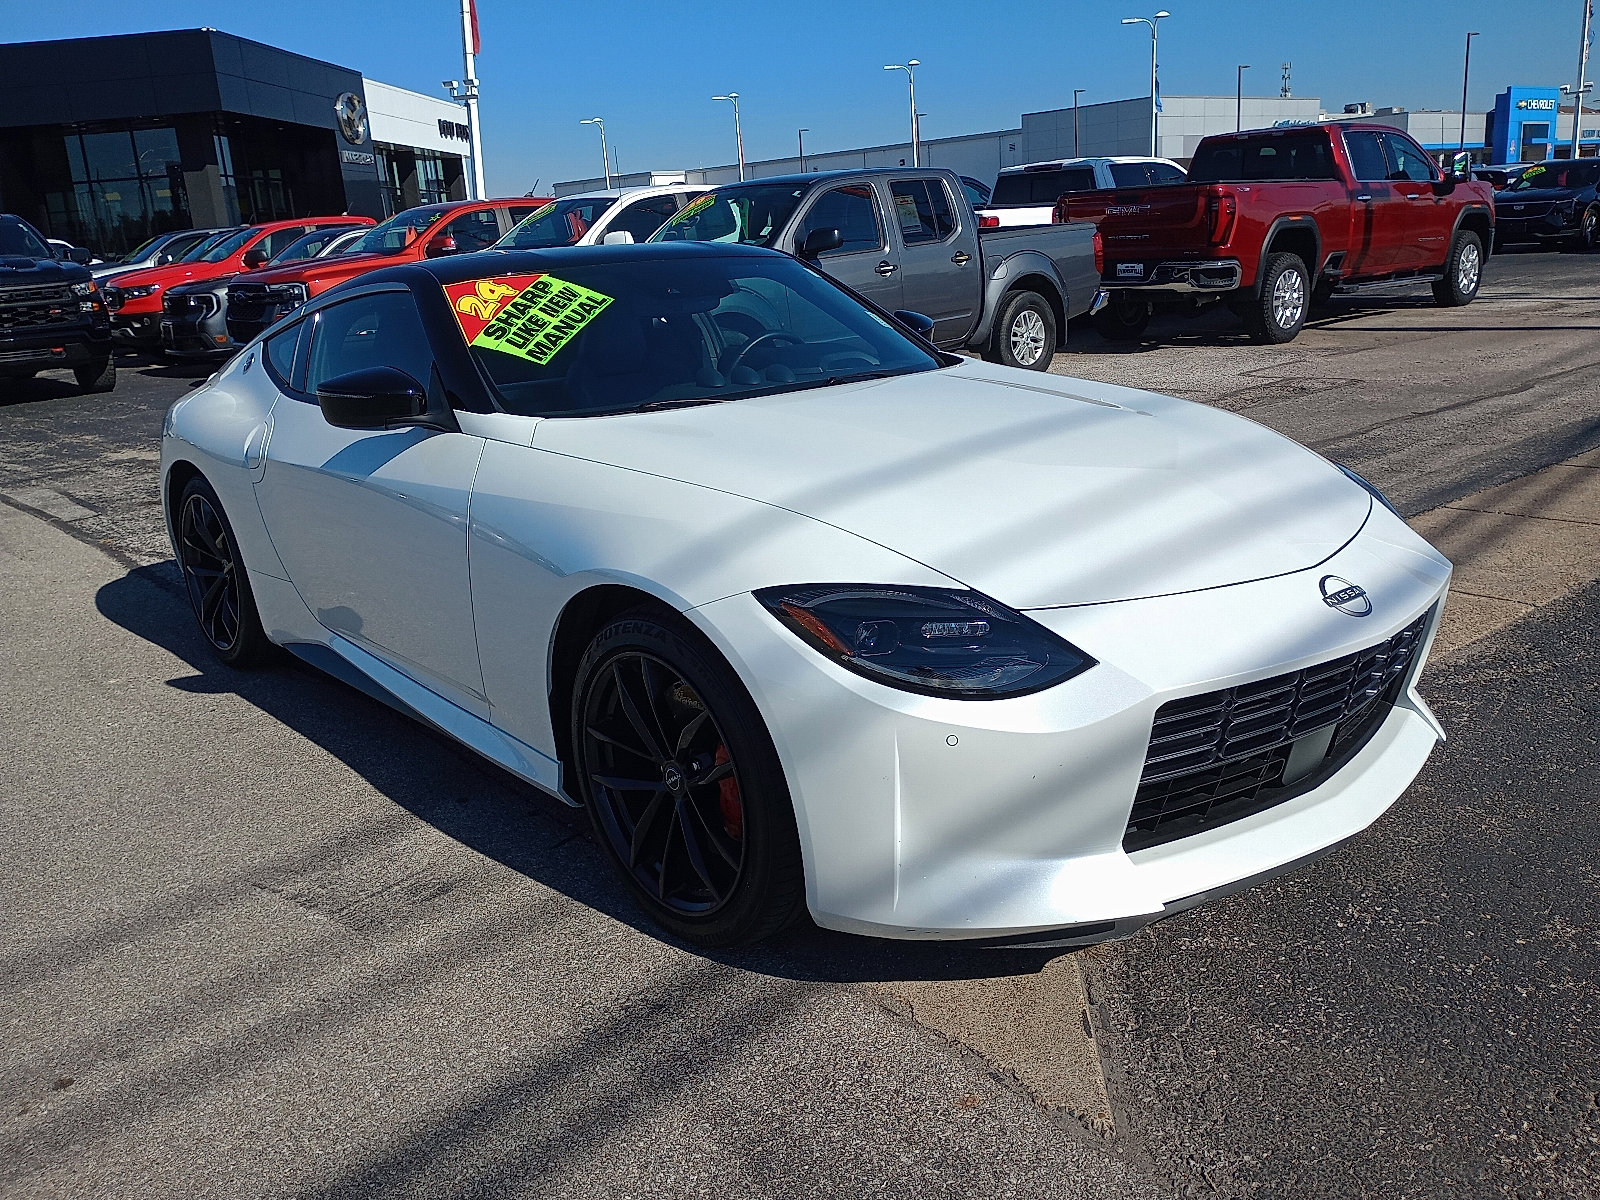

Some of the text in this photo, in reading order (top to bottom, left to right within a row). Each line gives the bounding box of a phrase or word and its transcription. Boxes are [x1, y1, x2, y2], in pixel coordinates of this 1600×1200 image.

[1527, 99, 1556, 110] CHEVROLET
[455, 280, 520, 321] 24
[483, 280, 553, 341] SHARP
[504, 286, 581, 350] LIKE NEW
[525, 296, 611, 363] MANUAL
[595, 621, 666, 648] POTENZA
